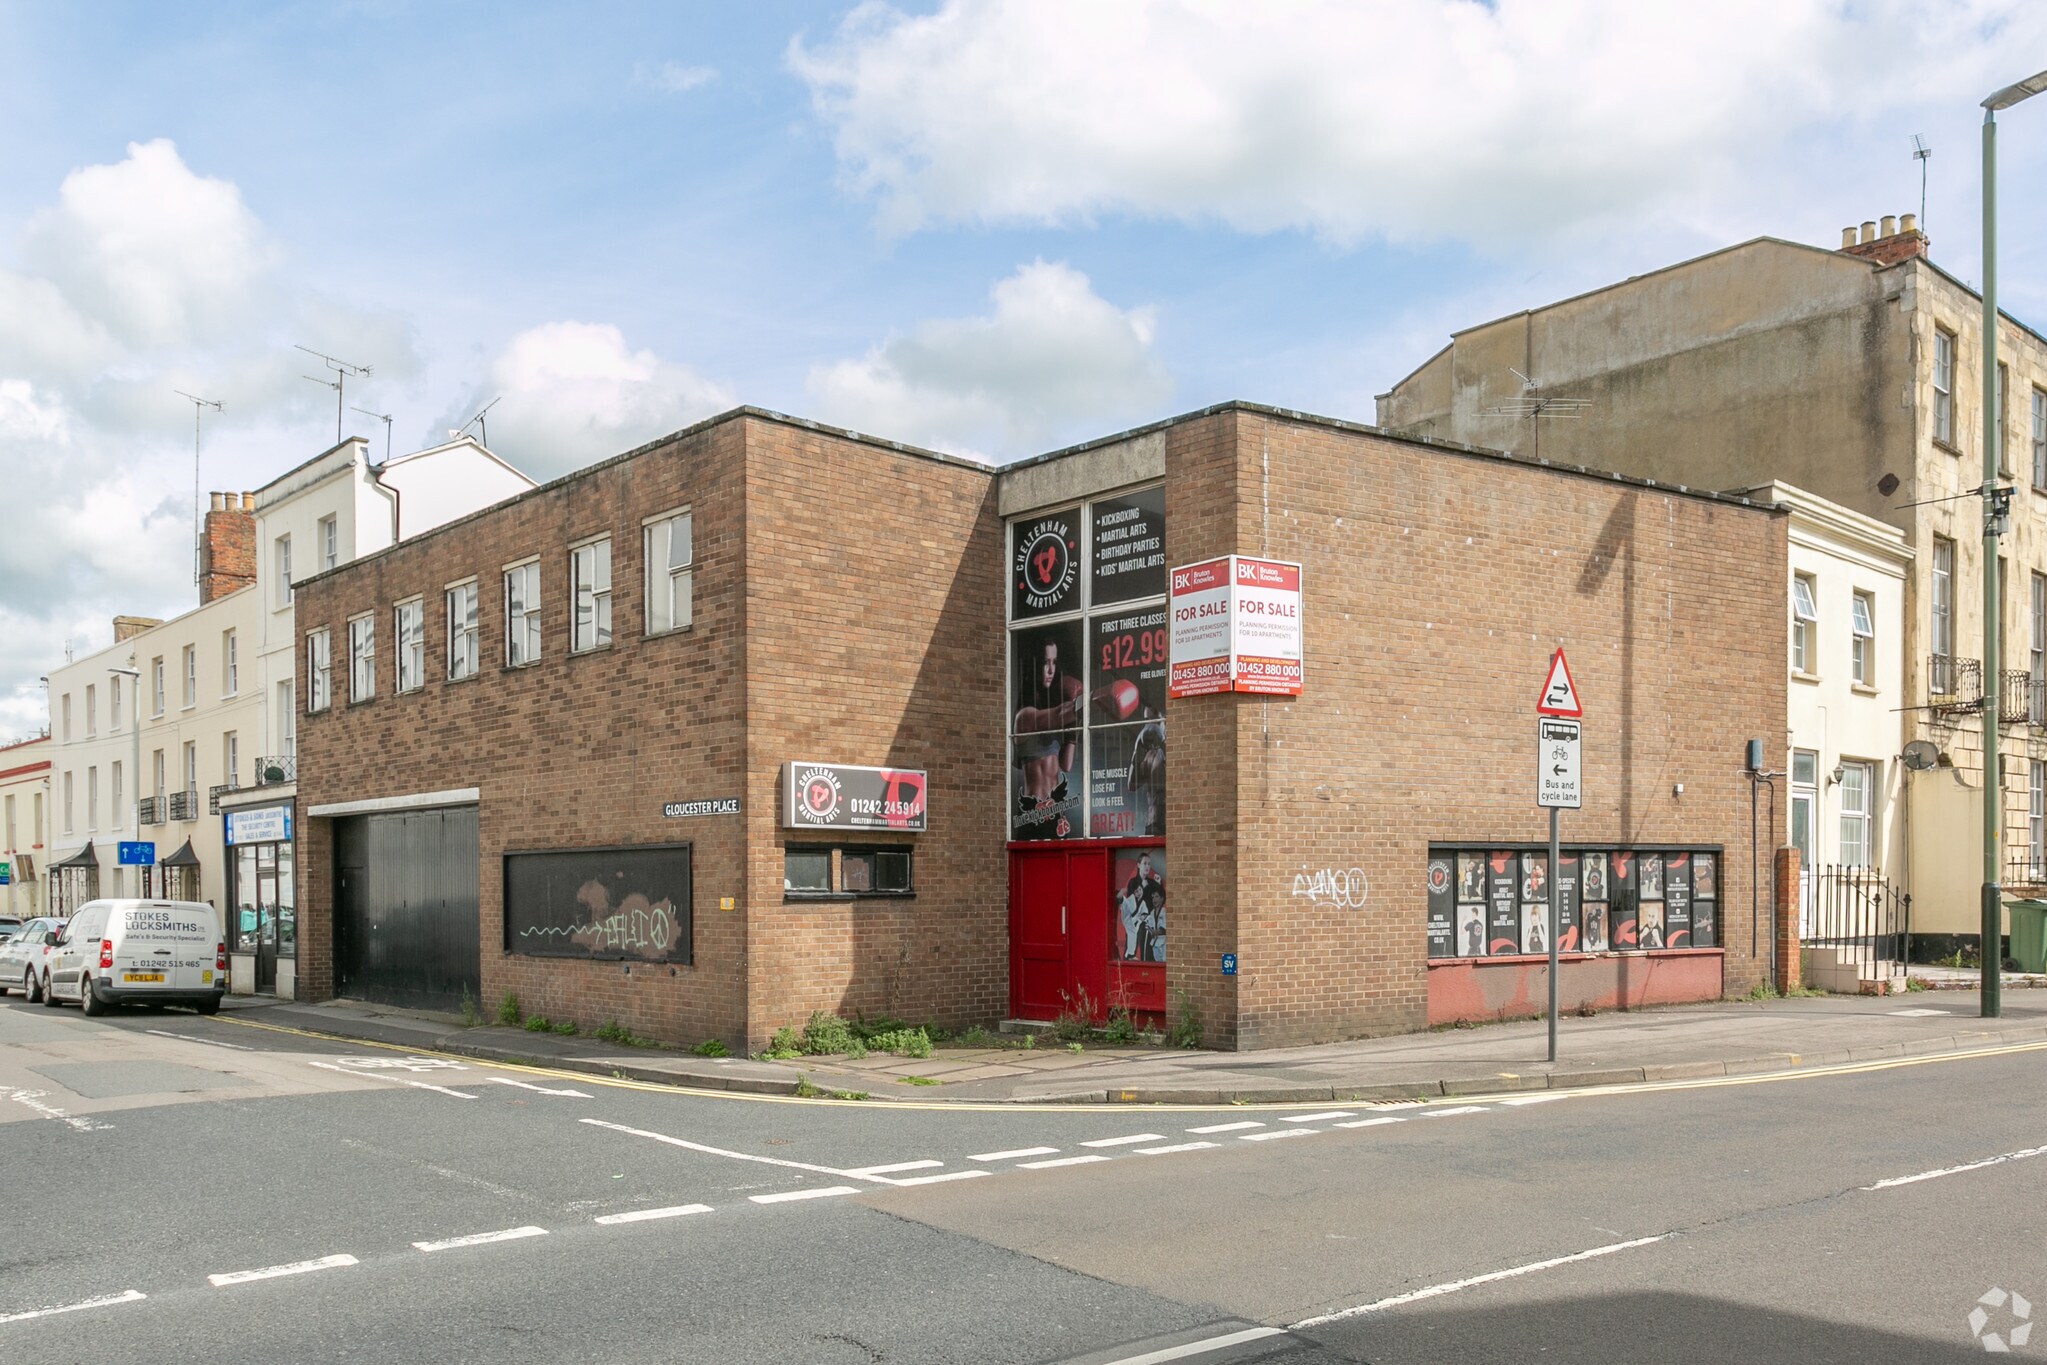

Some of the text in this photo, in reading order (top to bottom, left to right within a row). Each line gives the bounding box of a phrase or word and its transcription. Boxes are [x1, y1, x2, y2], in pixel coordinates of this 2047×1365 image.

[1101, 507, 1140, 527] KICKBOXING
[1101, 523, 1147, 543] MARTIAL ARTS
[1016, 520, 1068, 572] CHELTENHAM
[1101, 537, 1160, 560] BIRTHDAY PARTIES
[1101, 553, 1165, 576] KIDS' MARTIAL ARTS
[1238, 564, 1257, 579] BK
[1260, 566, 1278, 576] Bruton
[1175, 573, 1190, 589] BK
[1193, 569, 1210, 578] Bruton
[1193, 575, 1215, 585] Knowles
[1260, 573, 1284, 583] Knowles
[1025, 561, 1078, 608] MARTIAL ARTS
[1175, 601, 1227, 622] FOR SALE
[1239, 600, 1296, 618] FOR SALE
[1101, 620, 1119, 633] FIRST
[1119, 617, 1139, 630] THREE
[1175, 622, 1229, 636] PLANNING PERMISSION
[1239, 621, 1298, 632] PLANNING PERMISSION
[1191, 631, 1223, 641] APARTMENTS
[1259, 631, 1291, 640] APARTMENTS
[1102, 629, 1166, 670] £12.99
[1141, 671, 1151, 679] FREE
[1173, 662, 1230, 680] 01452 880 000
[1237, 662, 1299, 677] 01452 880 000
[799, 767, 842, 790] CHELTENHAM
[1092, 767, 1128, 779] TONE MUSCLE
[1092, 783, 1115, 793] LOSE FAT
[1545, 779, 1574, 790] Bus and
[1092, 797, 1105, 807] LOOK
[1111, 796, 1124, 806] FEEL
[1541, 791, 1577, 801] cycle lane
[665, 799, 737, 815] GLOUCESTER PLACE
[798, 803, 841, 825] MARTIAL ARTS
[851, 798, 920, 816] 01242 245914
[1091, 811, 1135, 833] GREAT!
[125, 912, 169, 921] STOKES
[125, 921, 197, 932] LOCKSMITHS
[1224, 960, 1234, 968] SV
